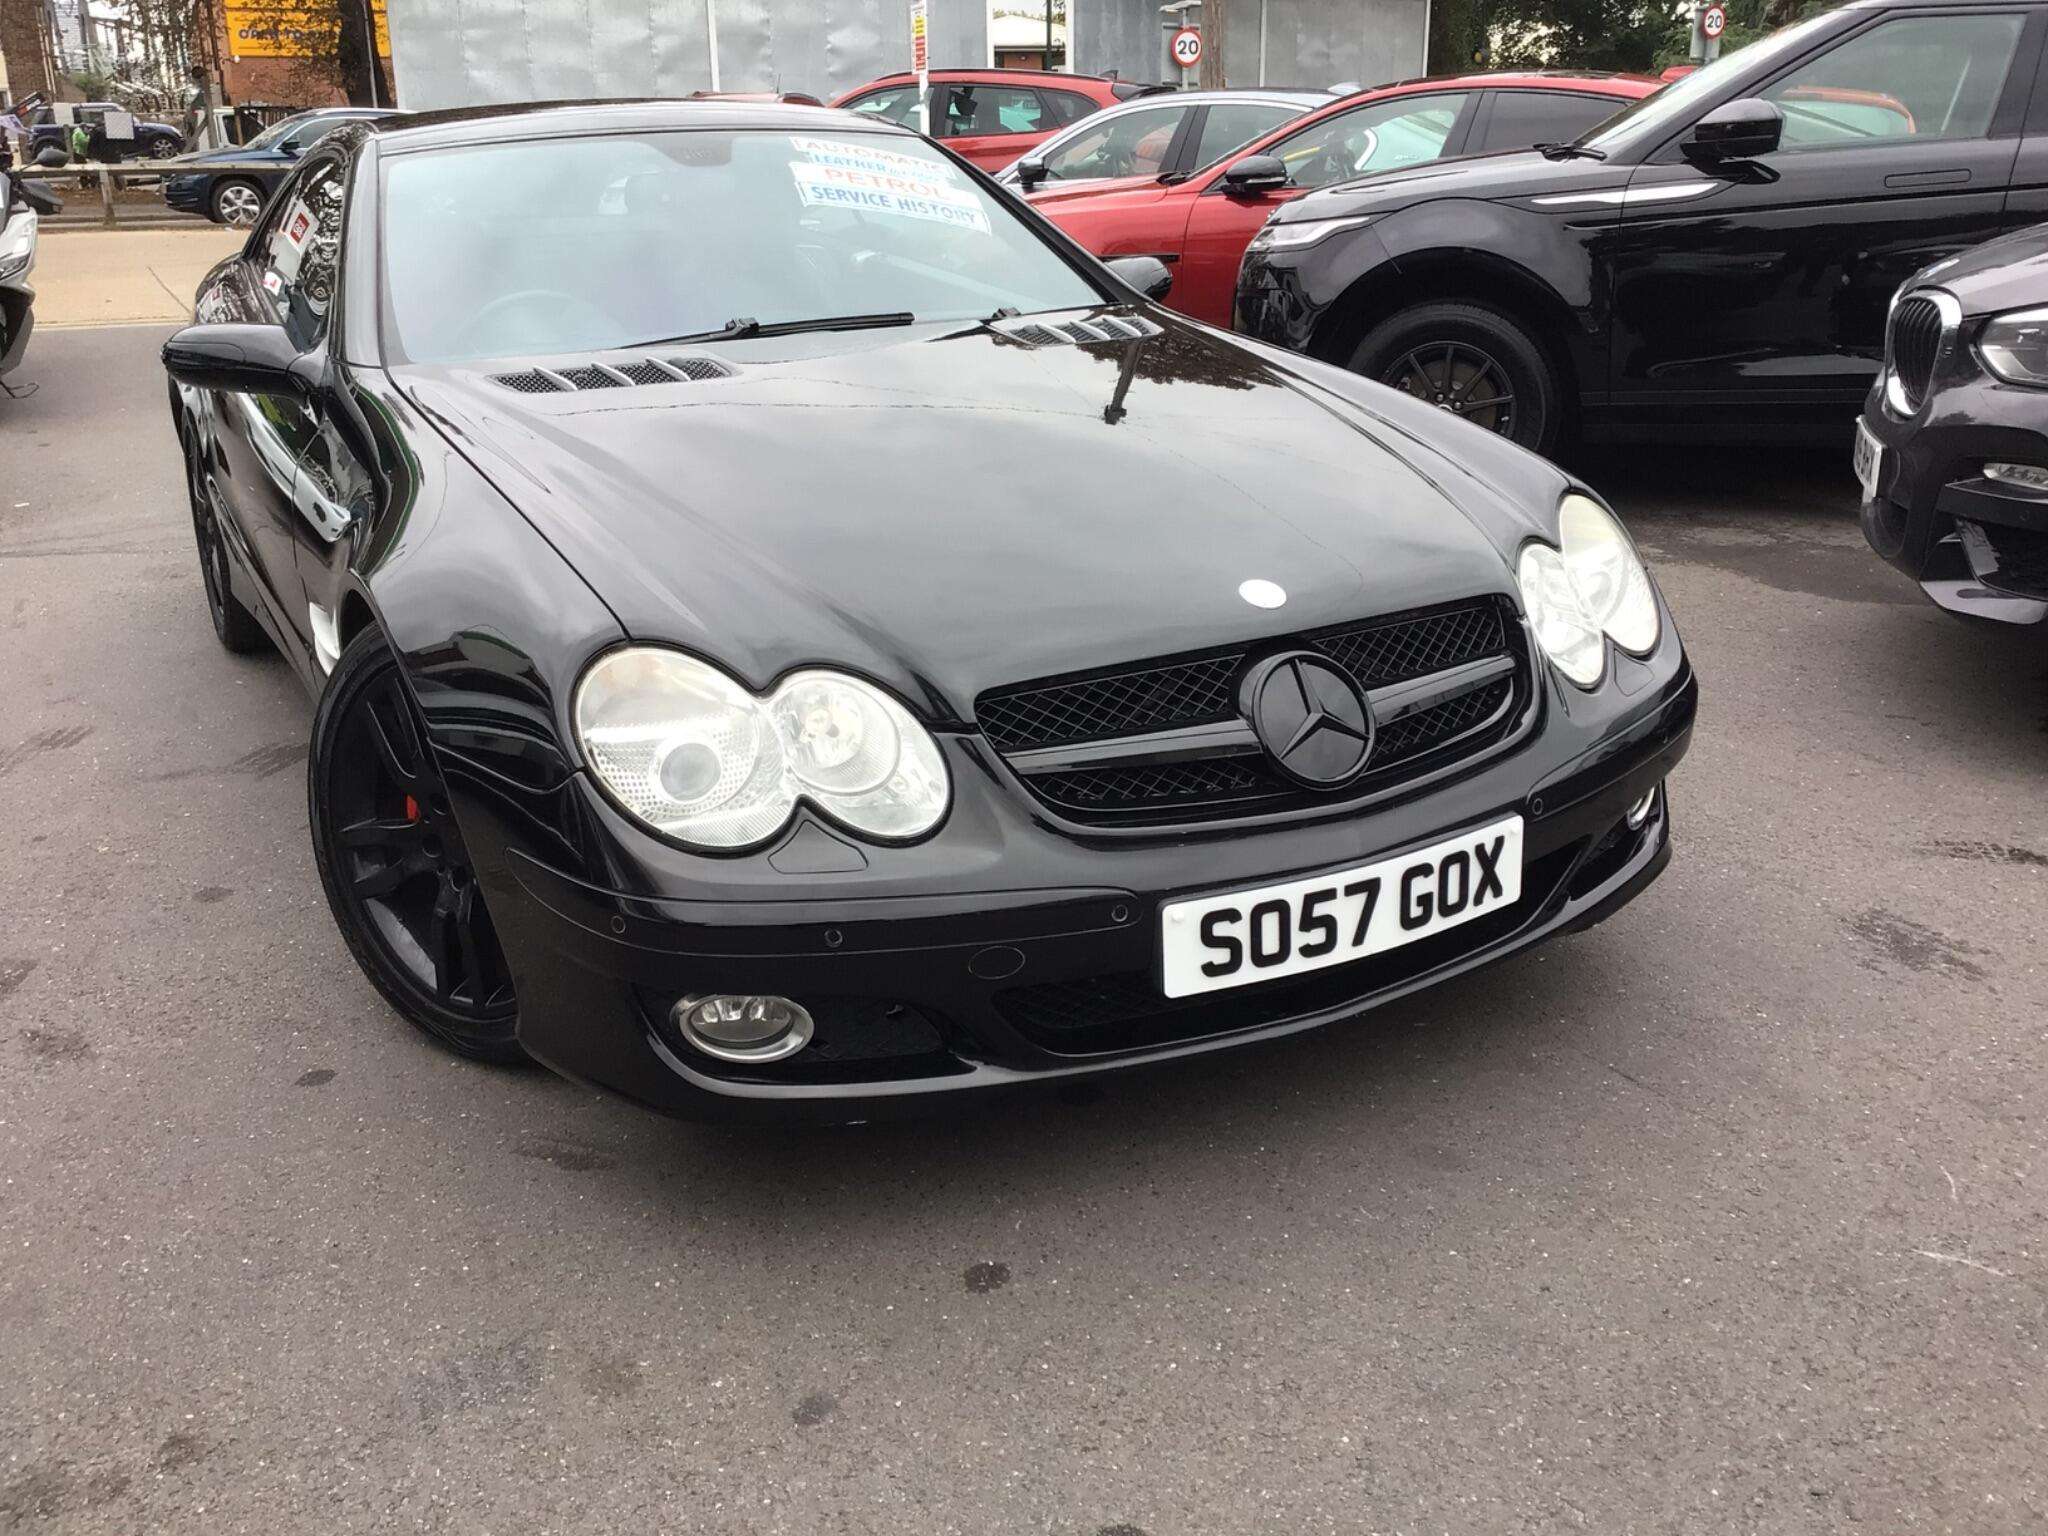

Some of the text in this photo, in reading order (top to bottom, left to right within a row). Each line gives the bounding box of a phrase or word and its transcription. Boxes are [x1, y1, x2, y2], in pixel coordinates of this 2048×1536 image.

[1707, 14, 1722, 28] 20
[1177, 39, 1198, 55] 20
[814, 153, 887, 173] LEATHER
[824, 168, 947, 198] PETROL
[811, 186, 976, 223] SERVICE HISTORY
[1199, 835, 1506, 979] SO57 GOX
